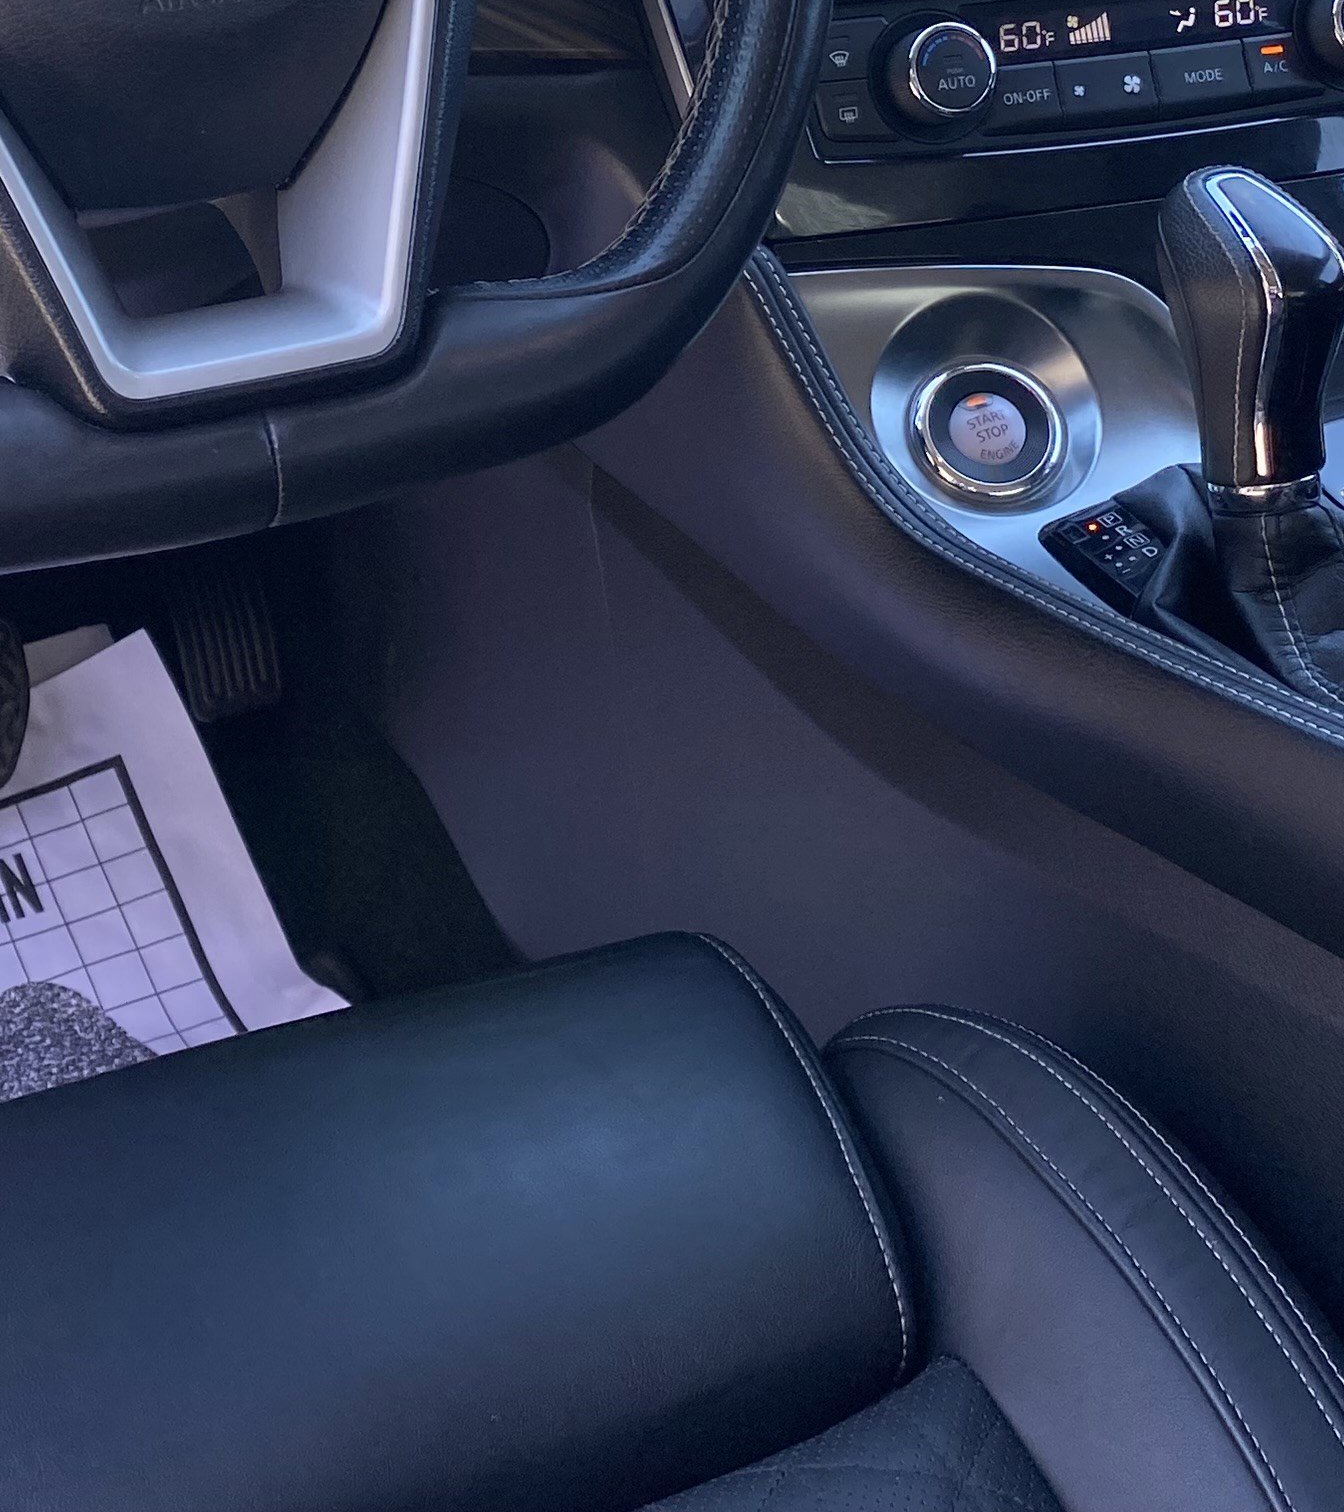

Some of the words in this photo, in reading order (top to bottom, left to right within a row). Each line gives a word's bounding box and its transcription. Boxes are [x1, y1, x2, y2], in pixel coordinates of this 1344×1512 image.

[1263, 60, 1288, 74] A/C
[937, 75, 976, 91] AUTO
[1184, 68, 1224, 84] MODE
[1003, 88, 1052, 106] ON-OFF
[966, 410, 1006, 431] START
[976, 423, 1009, 443] STOP
[980, 439, 1019, 460] ENGINE
[1115, 525, 1133, 537] R
[1141, 547, 1158, 558] D
